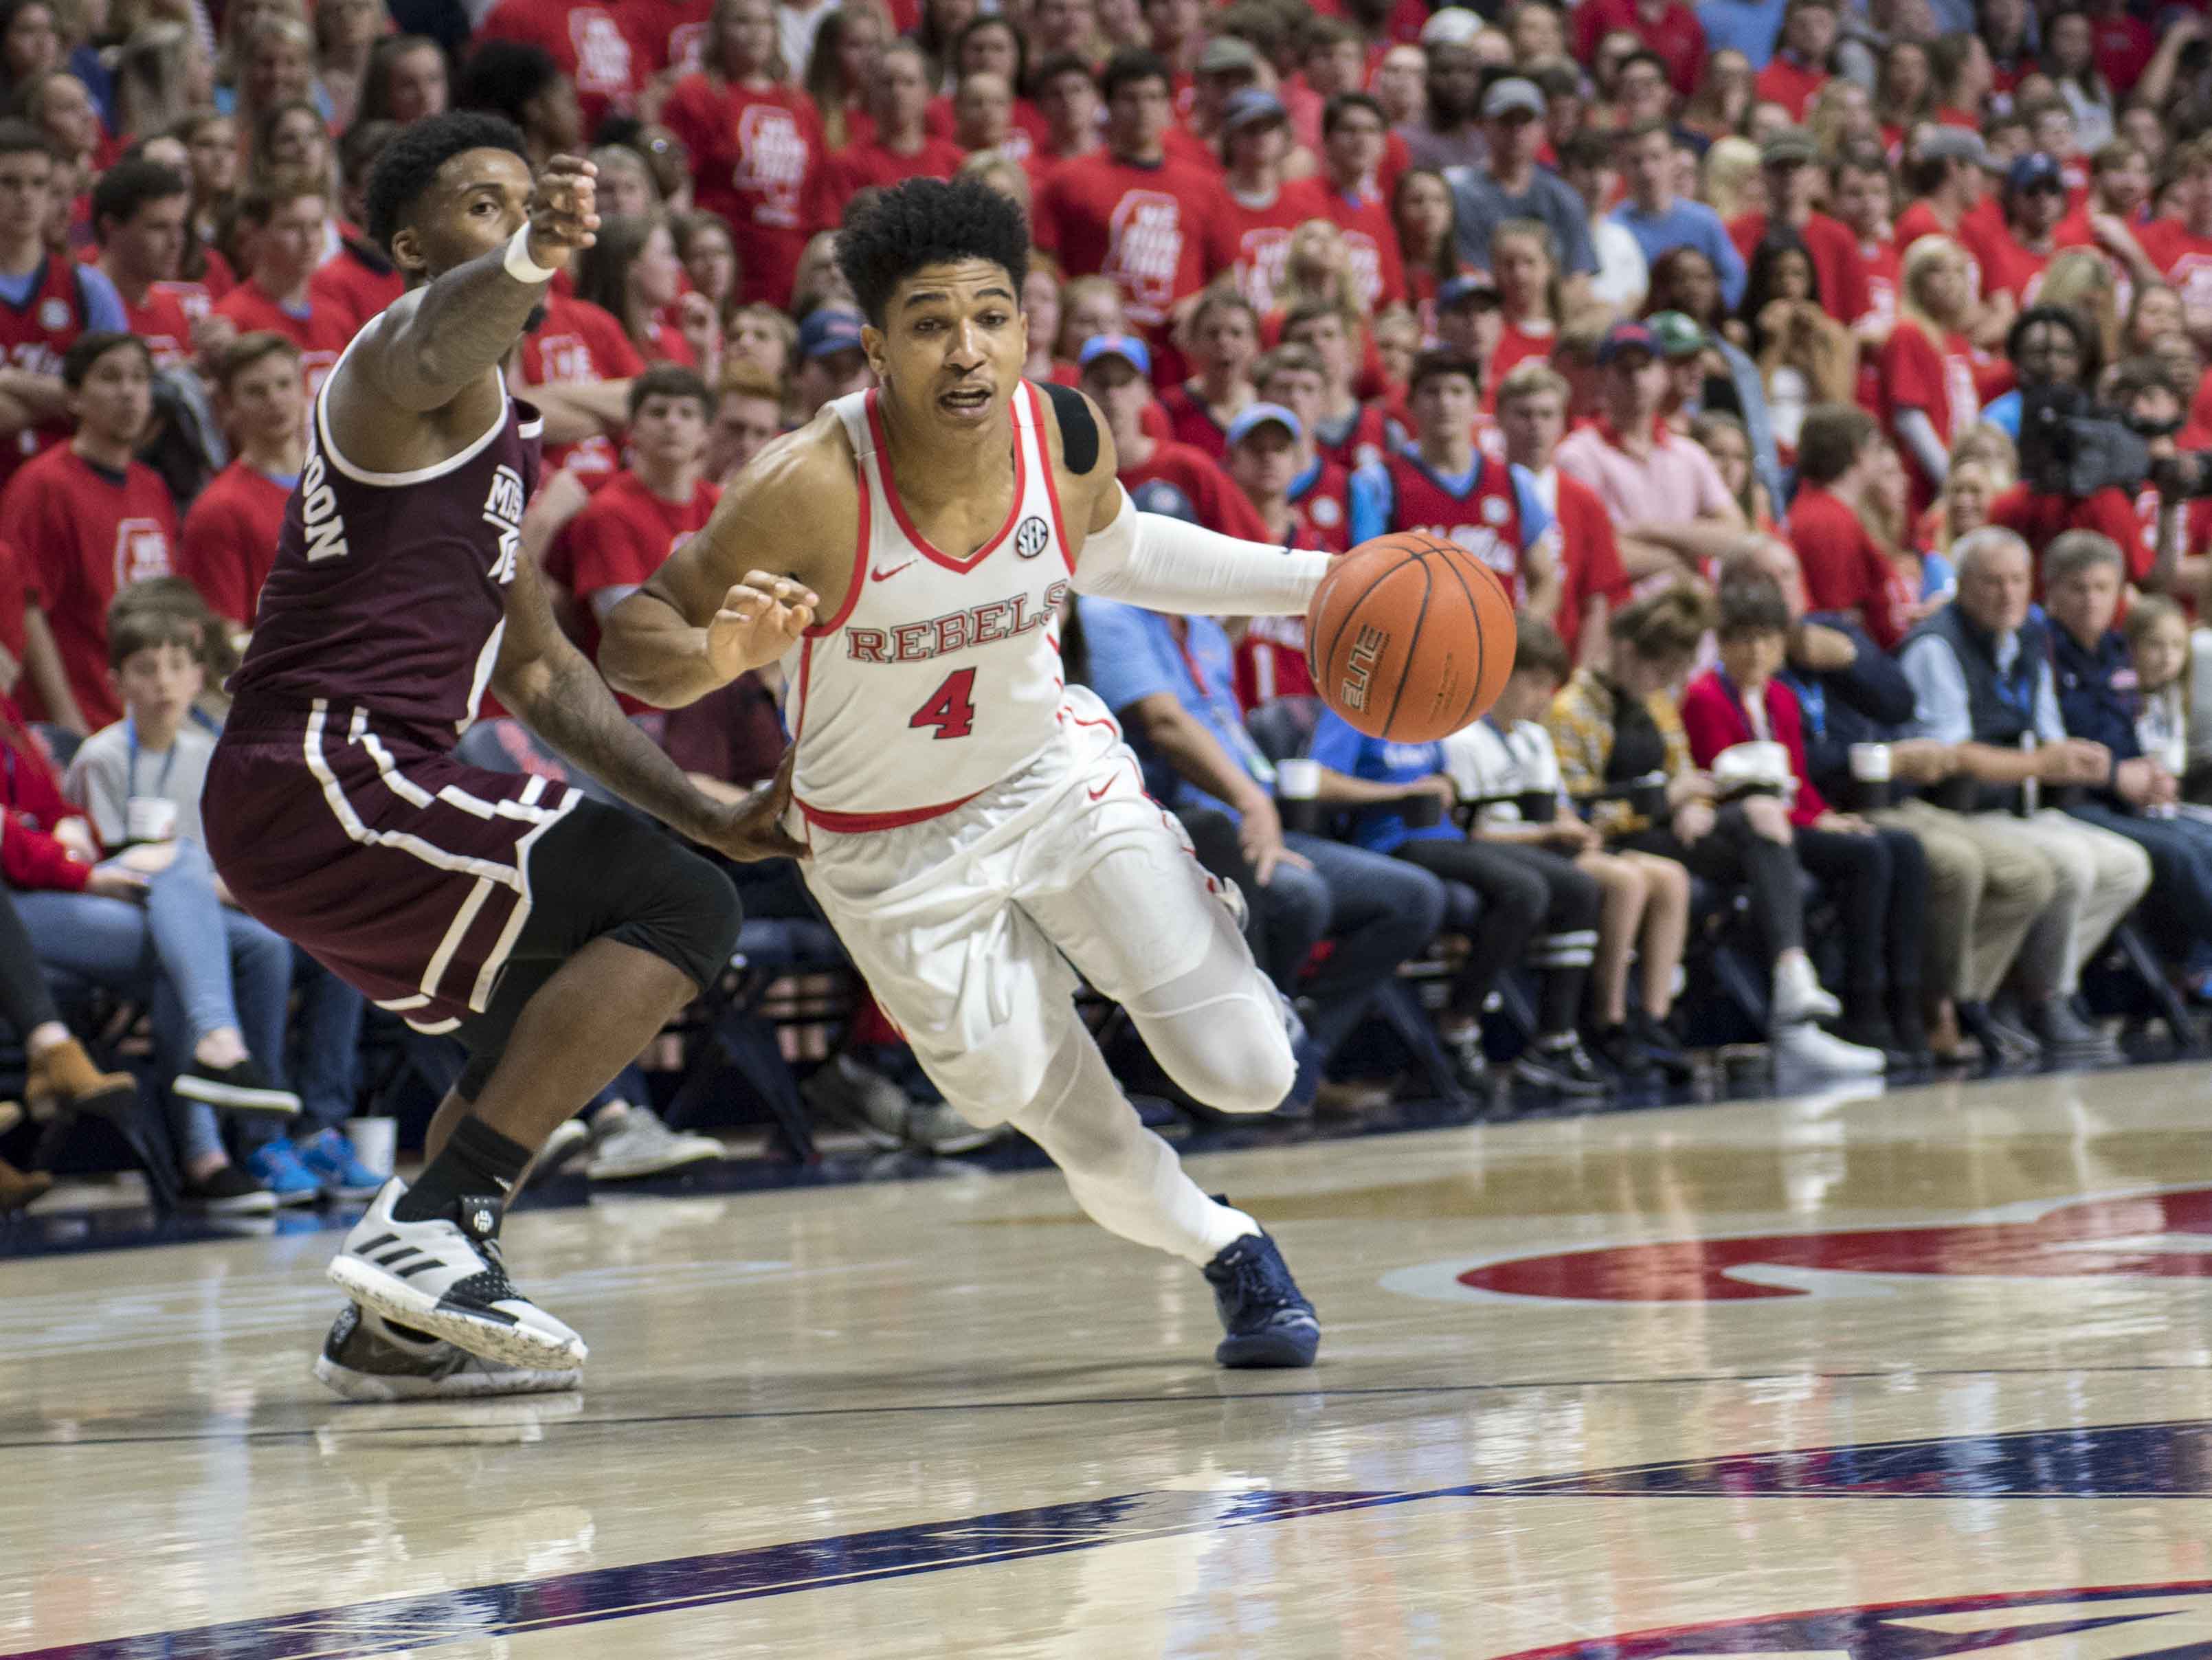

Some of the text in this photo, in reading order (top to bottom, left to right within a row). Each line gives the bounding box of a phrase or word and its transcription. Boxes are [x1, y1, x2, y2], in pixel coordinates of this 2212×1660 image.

[303, 438, 348, 563] OON
[1017, 518, 1047, 557] SEC
[846, 579, 1067, 664] REBELS
[908, 665, 977, 739] 4
[1341, 624, 1383, 712] ELITE
